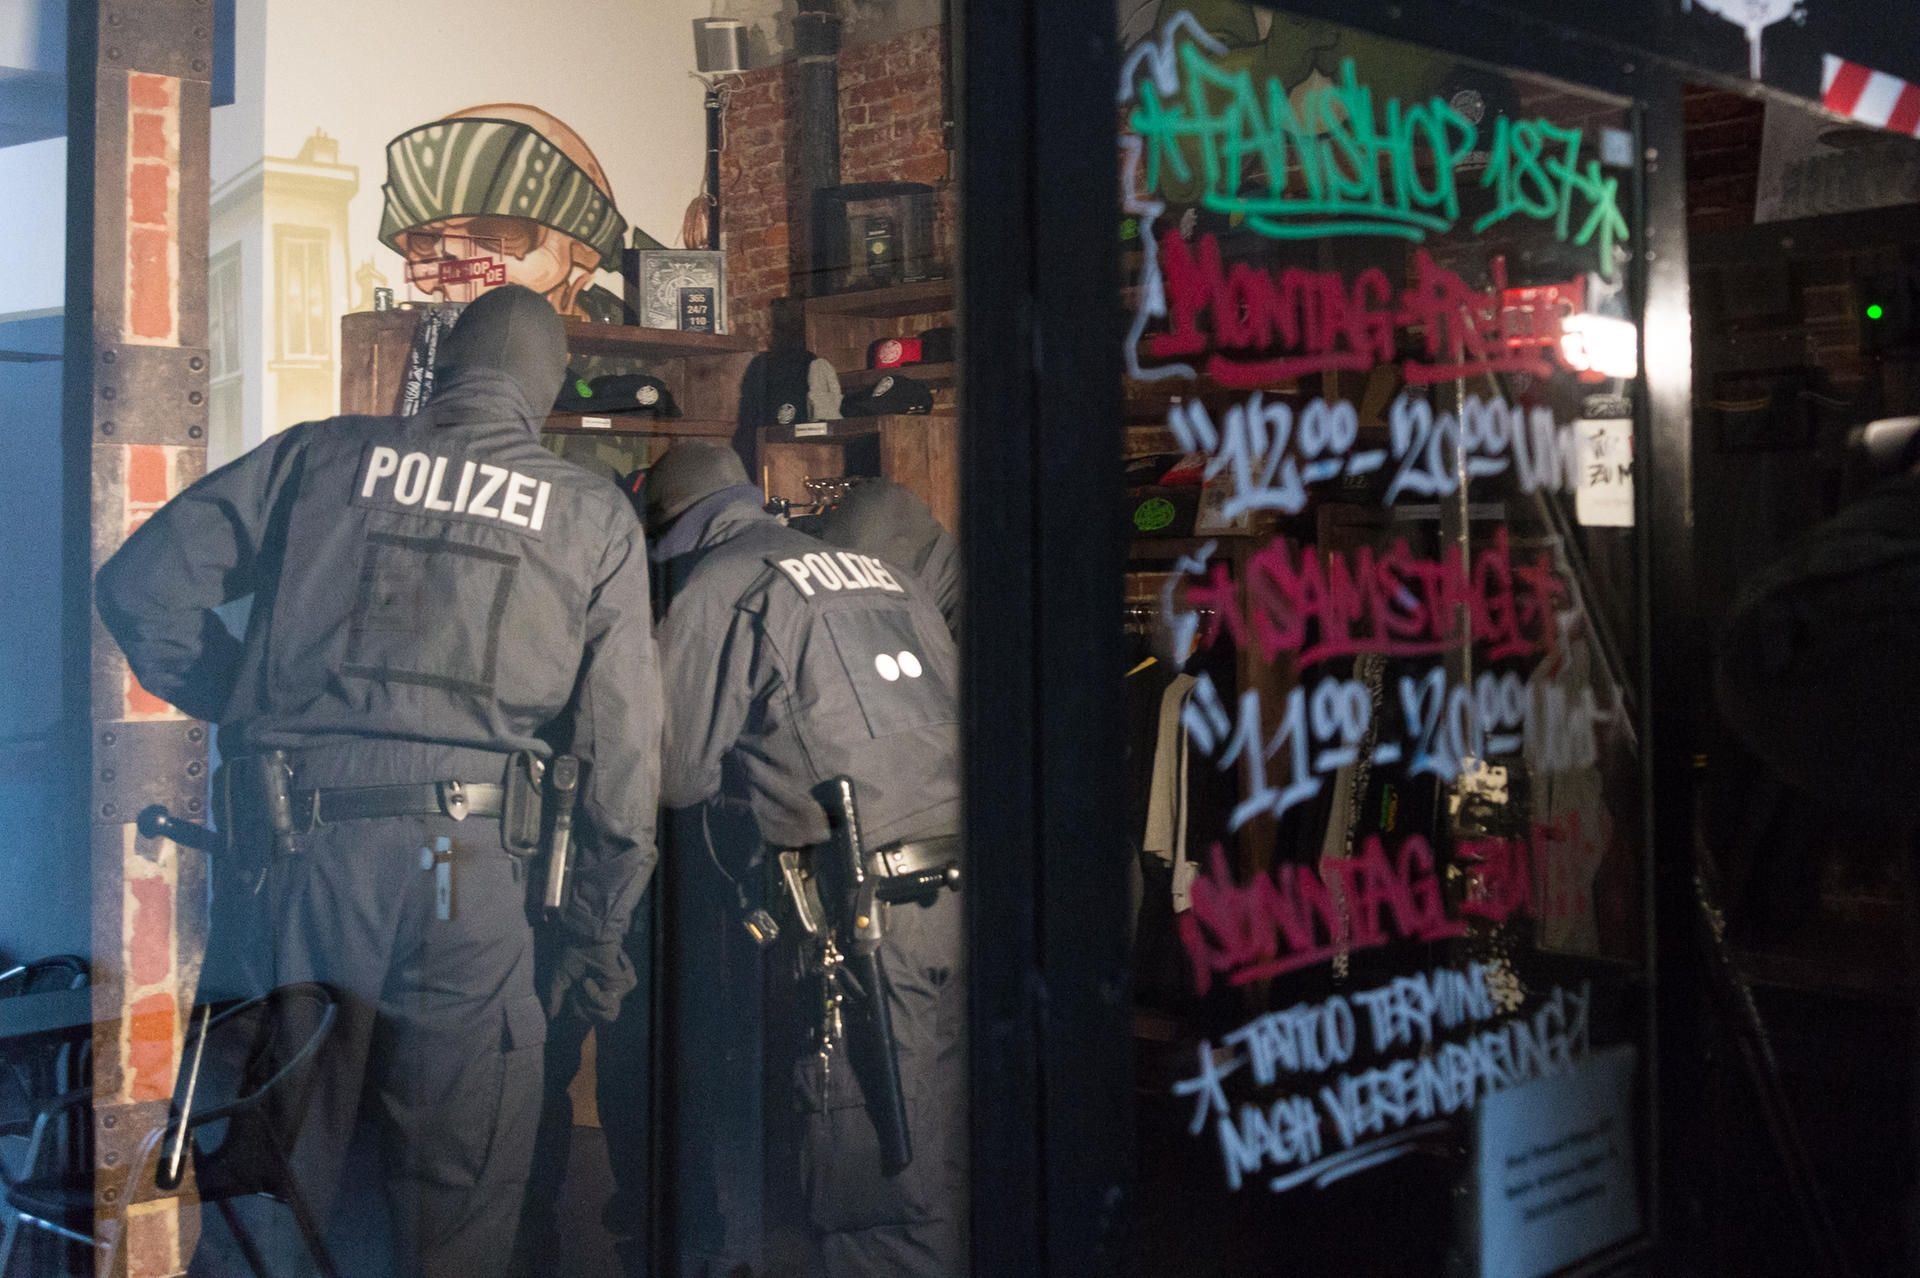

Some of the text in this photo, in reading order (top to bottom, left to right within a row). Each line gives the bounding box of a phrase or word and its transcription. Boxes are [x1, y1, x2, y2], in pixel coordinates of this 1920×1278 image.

[1180, 42, 1584, 242] FANSHOP 187
[687, 305, 708, 314] 24/7
[361, 446, 552, 531] POLIZEI
[779, 551, 905, 596] POLIZEI
